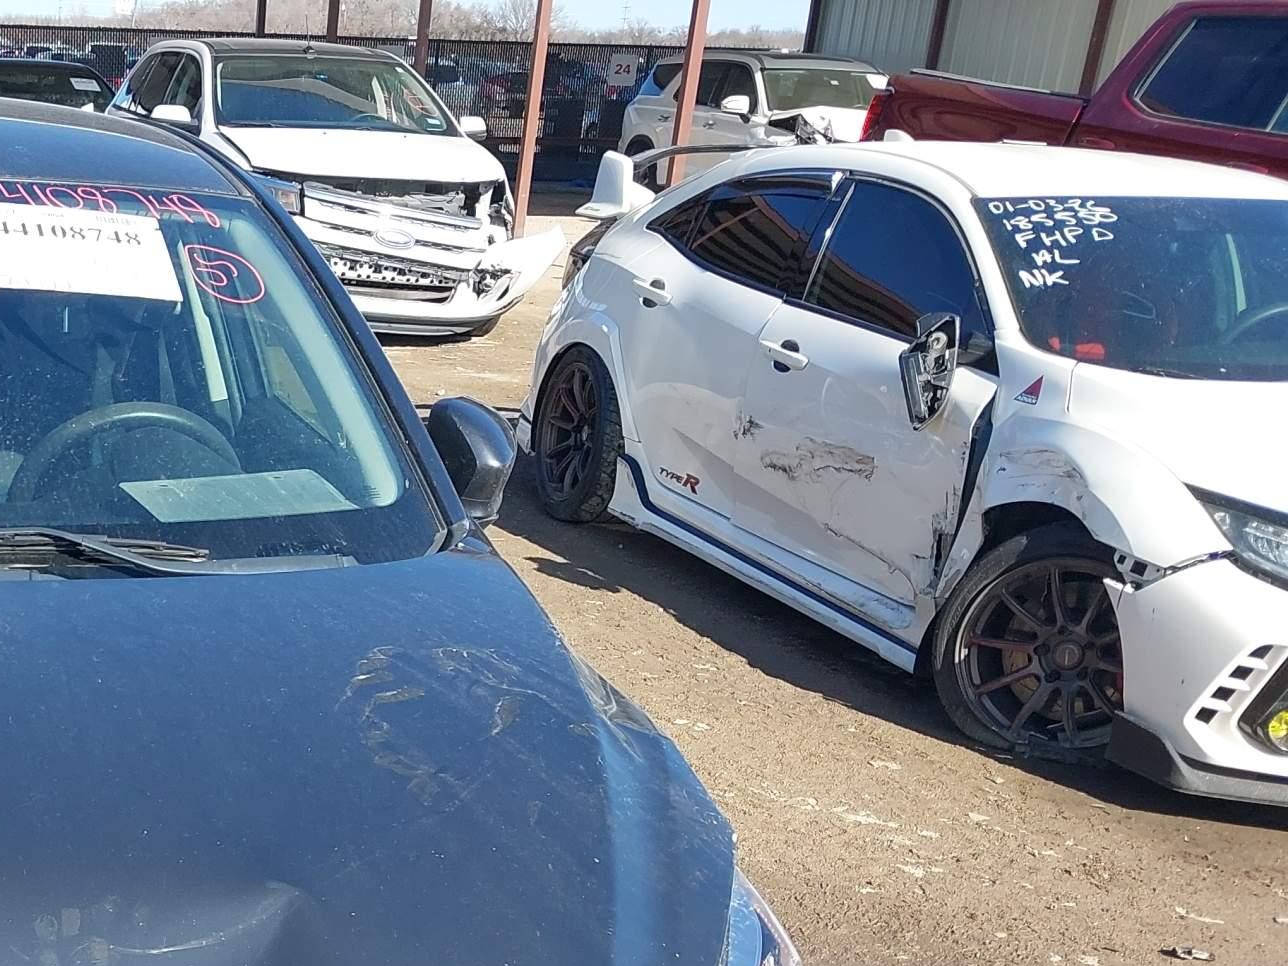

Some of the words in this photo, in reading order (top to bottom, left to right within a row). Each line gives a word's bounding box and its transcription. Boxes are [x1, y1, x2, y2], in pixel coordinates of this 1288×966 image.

[614, 63, 631, 75] 24
[193, 253, 238, 287] 5
[659, 466, 685, 484] TYPE
[682, 472, 700, 496] R
